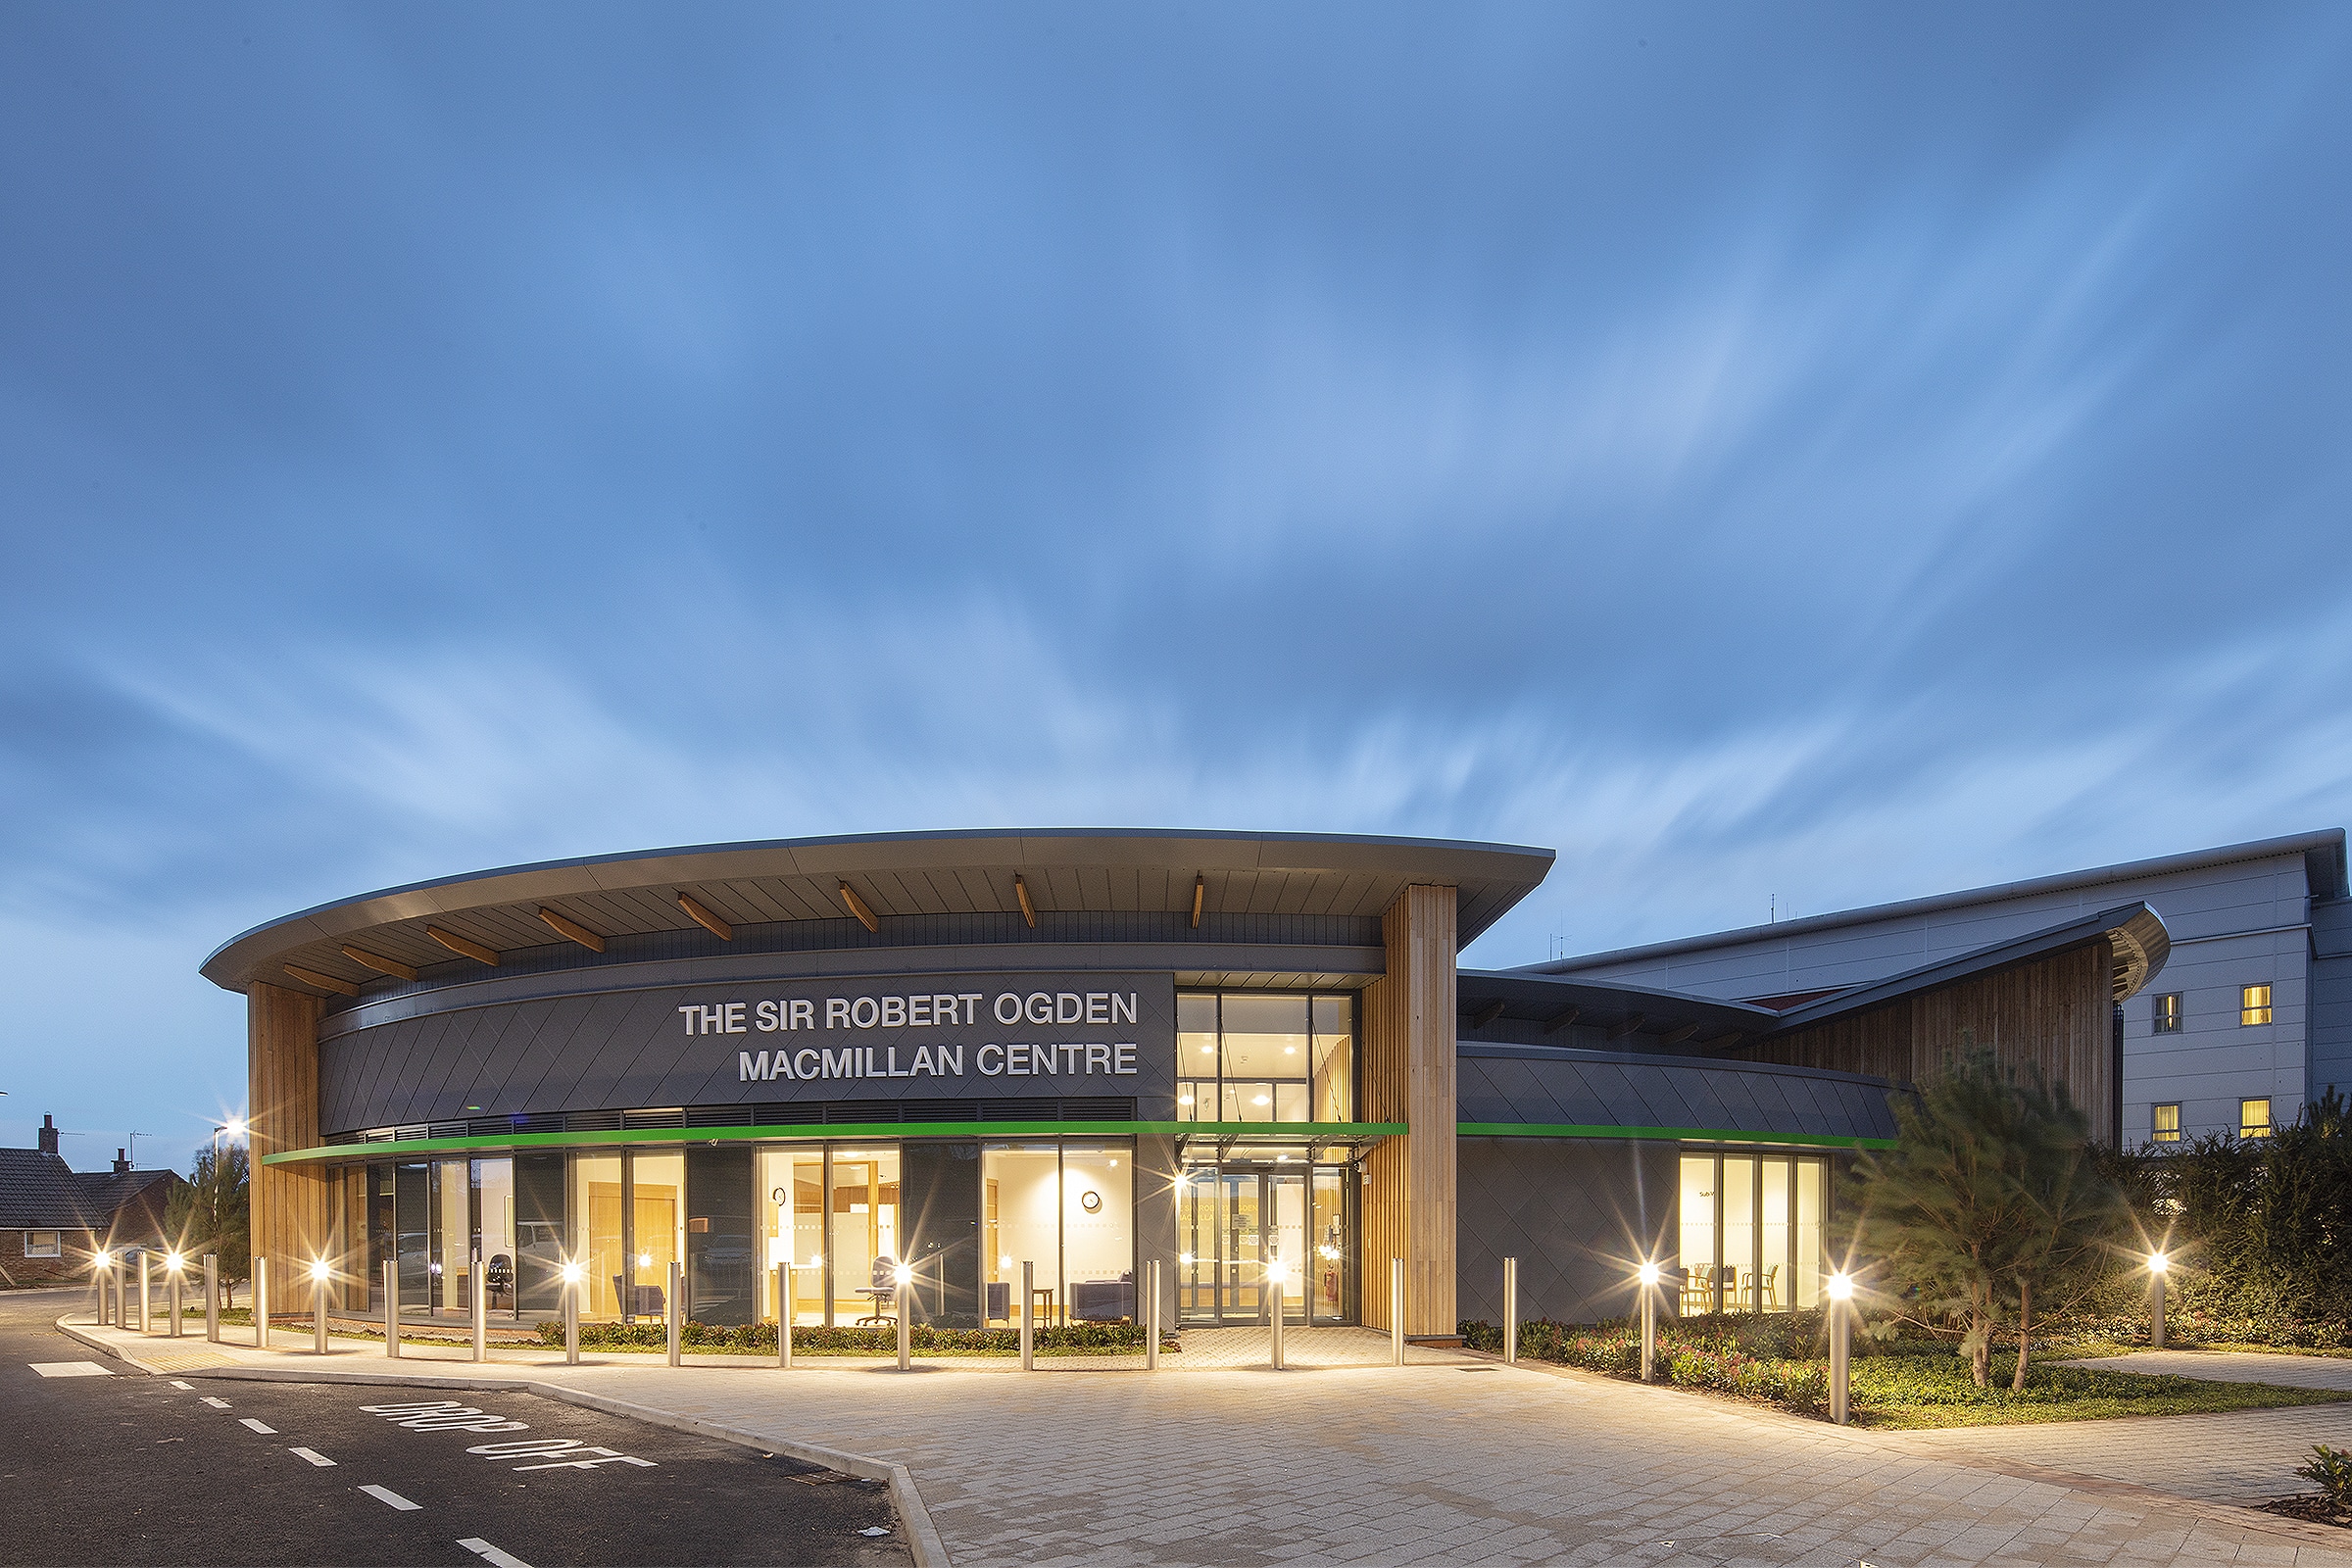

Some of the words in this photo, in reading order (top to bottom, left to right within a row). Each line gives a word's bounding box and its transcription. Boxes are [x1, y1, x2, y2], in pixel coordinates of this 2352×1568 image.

[678, 1002, 747, 1036] THE
[755, 999, 815, 1032] SIR
[826, 993, 983, 1029] ROBERT
[993, 992, 1137, 1025] OGDEN
[739, 1045, 963, 1081] MACMILLAN
[976, 1044, 1137, 1076] CENTRE
[359, 1400, 530, 1433] DROP
[466, 1439, 660, 1471] OFF
